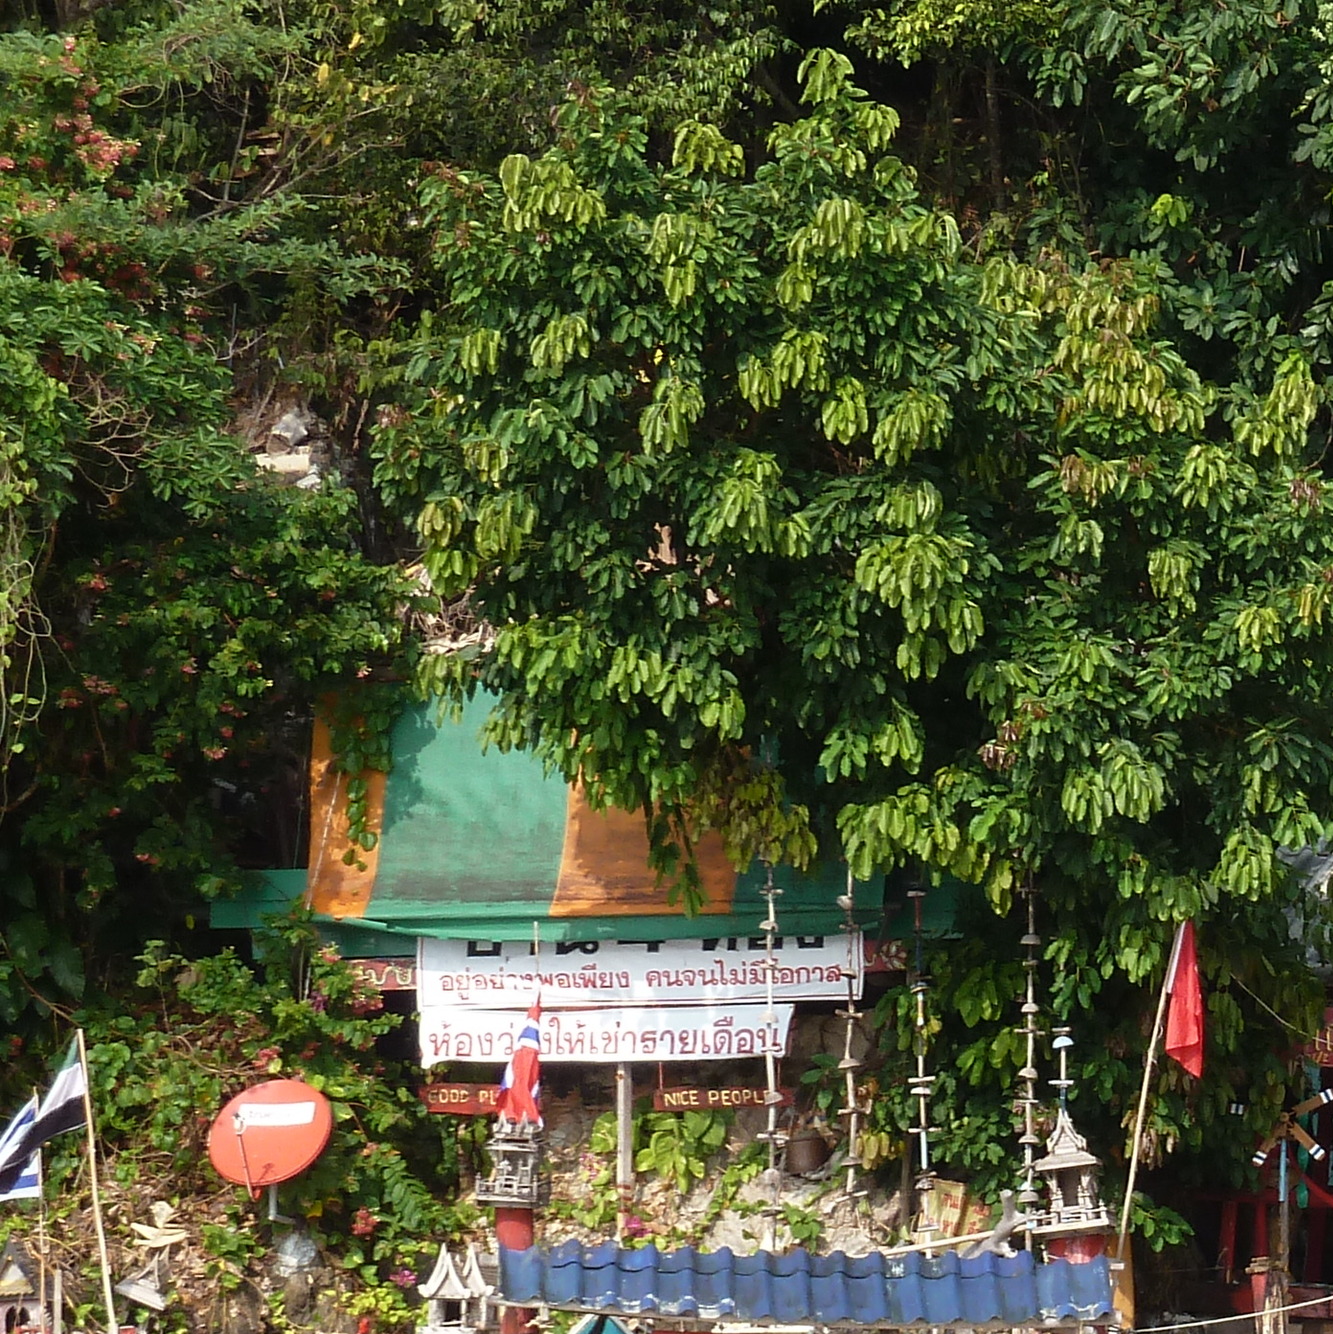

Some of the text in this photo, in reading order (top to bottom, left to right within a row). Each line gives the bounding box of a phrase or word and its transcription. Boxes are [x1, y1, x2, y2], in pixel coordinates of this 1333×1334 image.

[429, 1016, 781, 1057] ห้องว่งให้เช่ารายเดือน
[664, 1091, 699, 1106] NICE
